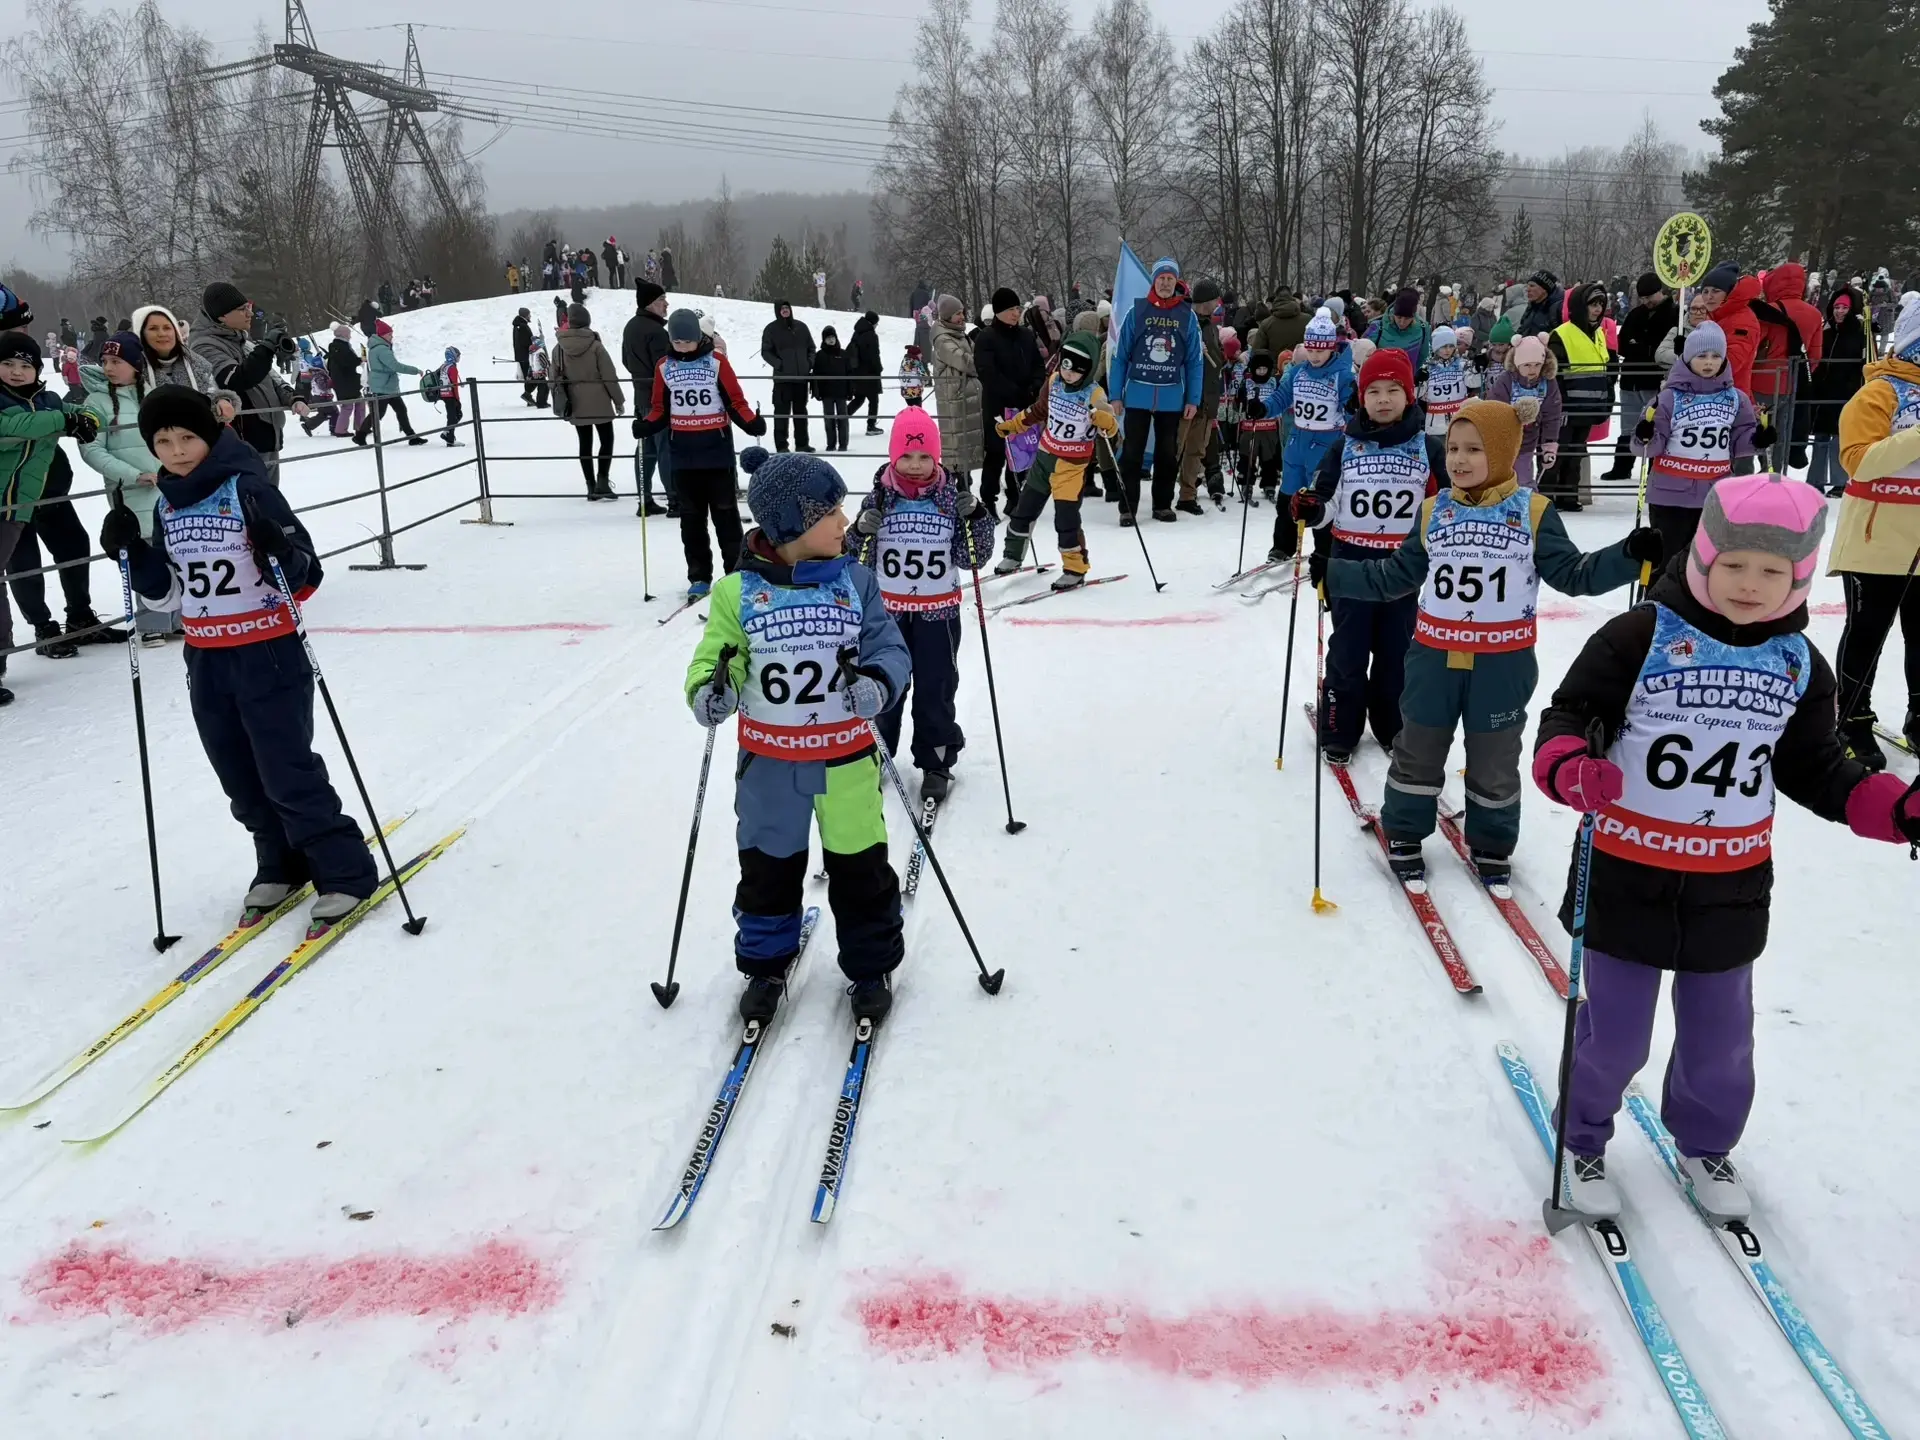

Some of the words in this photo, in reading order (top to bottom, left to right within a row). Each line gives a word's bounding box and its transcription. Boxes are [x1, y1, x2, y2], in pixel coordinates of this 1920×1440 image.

[1145, 316, 1179, 327] СУДЬЯ
[1136, 363, 1177, 372] КРАСНОГОРСК
[674, 388, 712, 407] 566
[1433, 381, 1460, 396] 591
[1295, 400, 1328, 421] 592
[1680, 426, 1730, 450] 556
[1343, 455, 1427, 473] КРЕЩЕНСКИЕ
[1359, 464, 1411, 475] МОРОЗЫ
[1367, 477, 1389, 485] Сергея
[1350, 489, 1415, 519] 662
[167, 516, 243, 532] ЕЩЕНСКИЕ
[881, 512, 953, 528] РЕЩЕНСКИ
[890, 523, 939, 533] МОРОЗЫ
[169, 529, 223, 546] МОРОЗЫ
[898, 536, 920, 545] Сергея
[1428, 521, 1529, 544] КРЕЩЕНСКИЕ
[883, 548, 946, 580] 655
[1451, 550, 1479, 560] Сергея
[120, 567, 132, 616] NORDWAY
[1434, 564, 1507, 602] 651
[275, 573, 298, 622] NORDWAY
[883, 596, 960, 612] АСНОГОРСК
[767, 621, 842, 639] МОРОЗЫ
[1417, 620, 1533, 643] КРАСНОГОРСК
[781, 643, 814, 655] Сергея
[1646, 669, 1799, 702] КРЕЩЕНСКИ
[1681, 688, 1782, 714] МОРОЗЫ
[1646, 710, 1688, 723] имени
[1694, 713, 1741, 731] Сергея
[743, 720, 869, 748] КРАСНОГОРС
[1646, 733, 1772, 798] 643
[1593, 812, 1771, 857] КРАСНОГОРС
[1575, 840, 1591, 908] NORDWAY
[276, 890, 306, 918] FISCHER
[342, 901, 371, 928] FISCHER
[680, 1096, 729, 1200] NORDWAY
[819, 1095, 855, 1194] NORDWAY
[1562, 1156, 1575, 1202] ORDWAY
[1657, 1352, 1712, 1440] NORD
